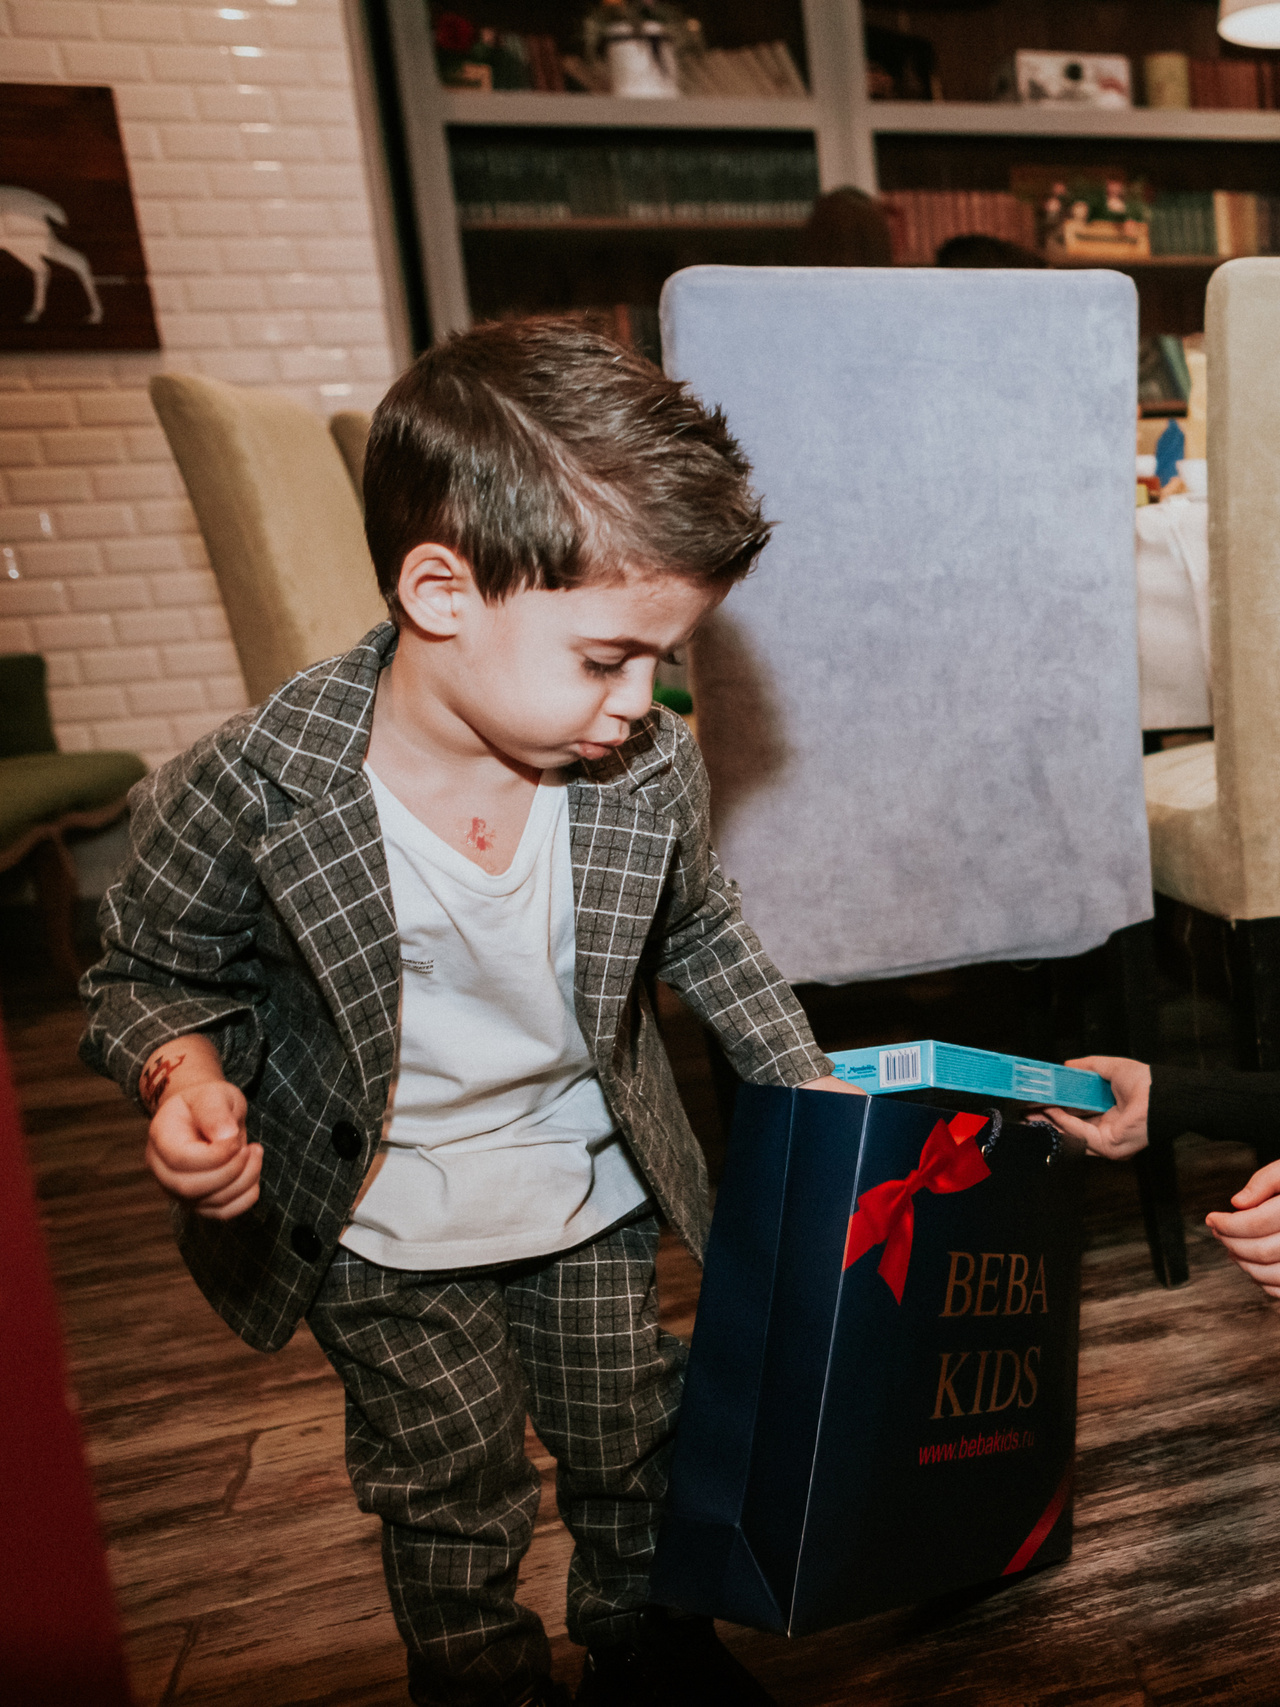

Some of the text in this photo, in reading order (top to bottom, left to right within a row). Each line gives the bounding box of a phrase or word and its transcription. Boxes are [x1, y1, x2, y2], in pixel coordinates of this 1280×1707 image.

[938, 1251, 1049, 1318] BEBA
[929, 1345, 1042, 1420] KIDS
[918, 1426, 1035, 1467] www.bebakids.ru
